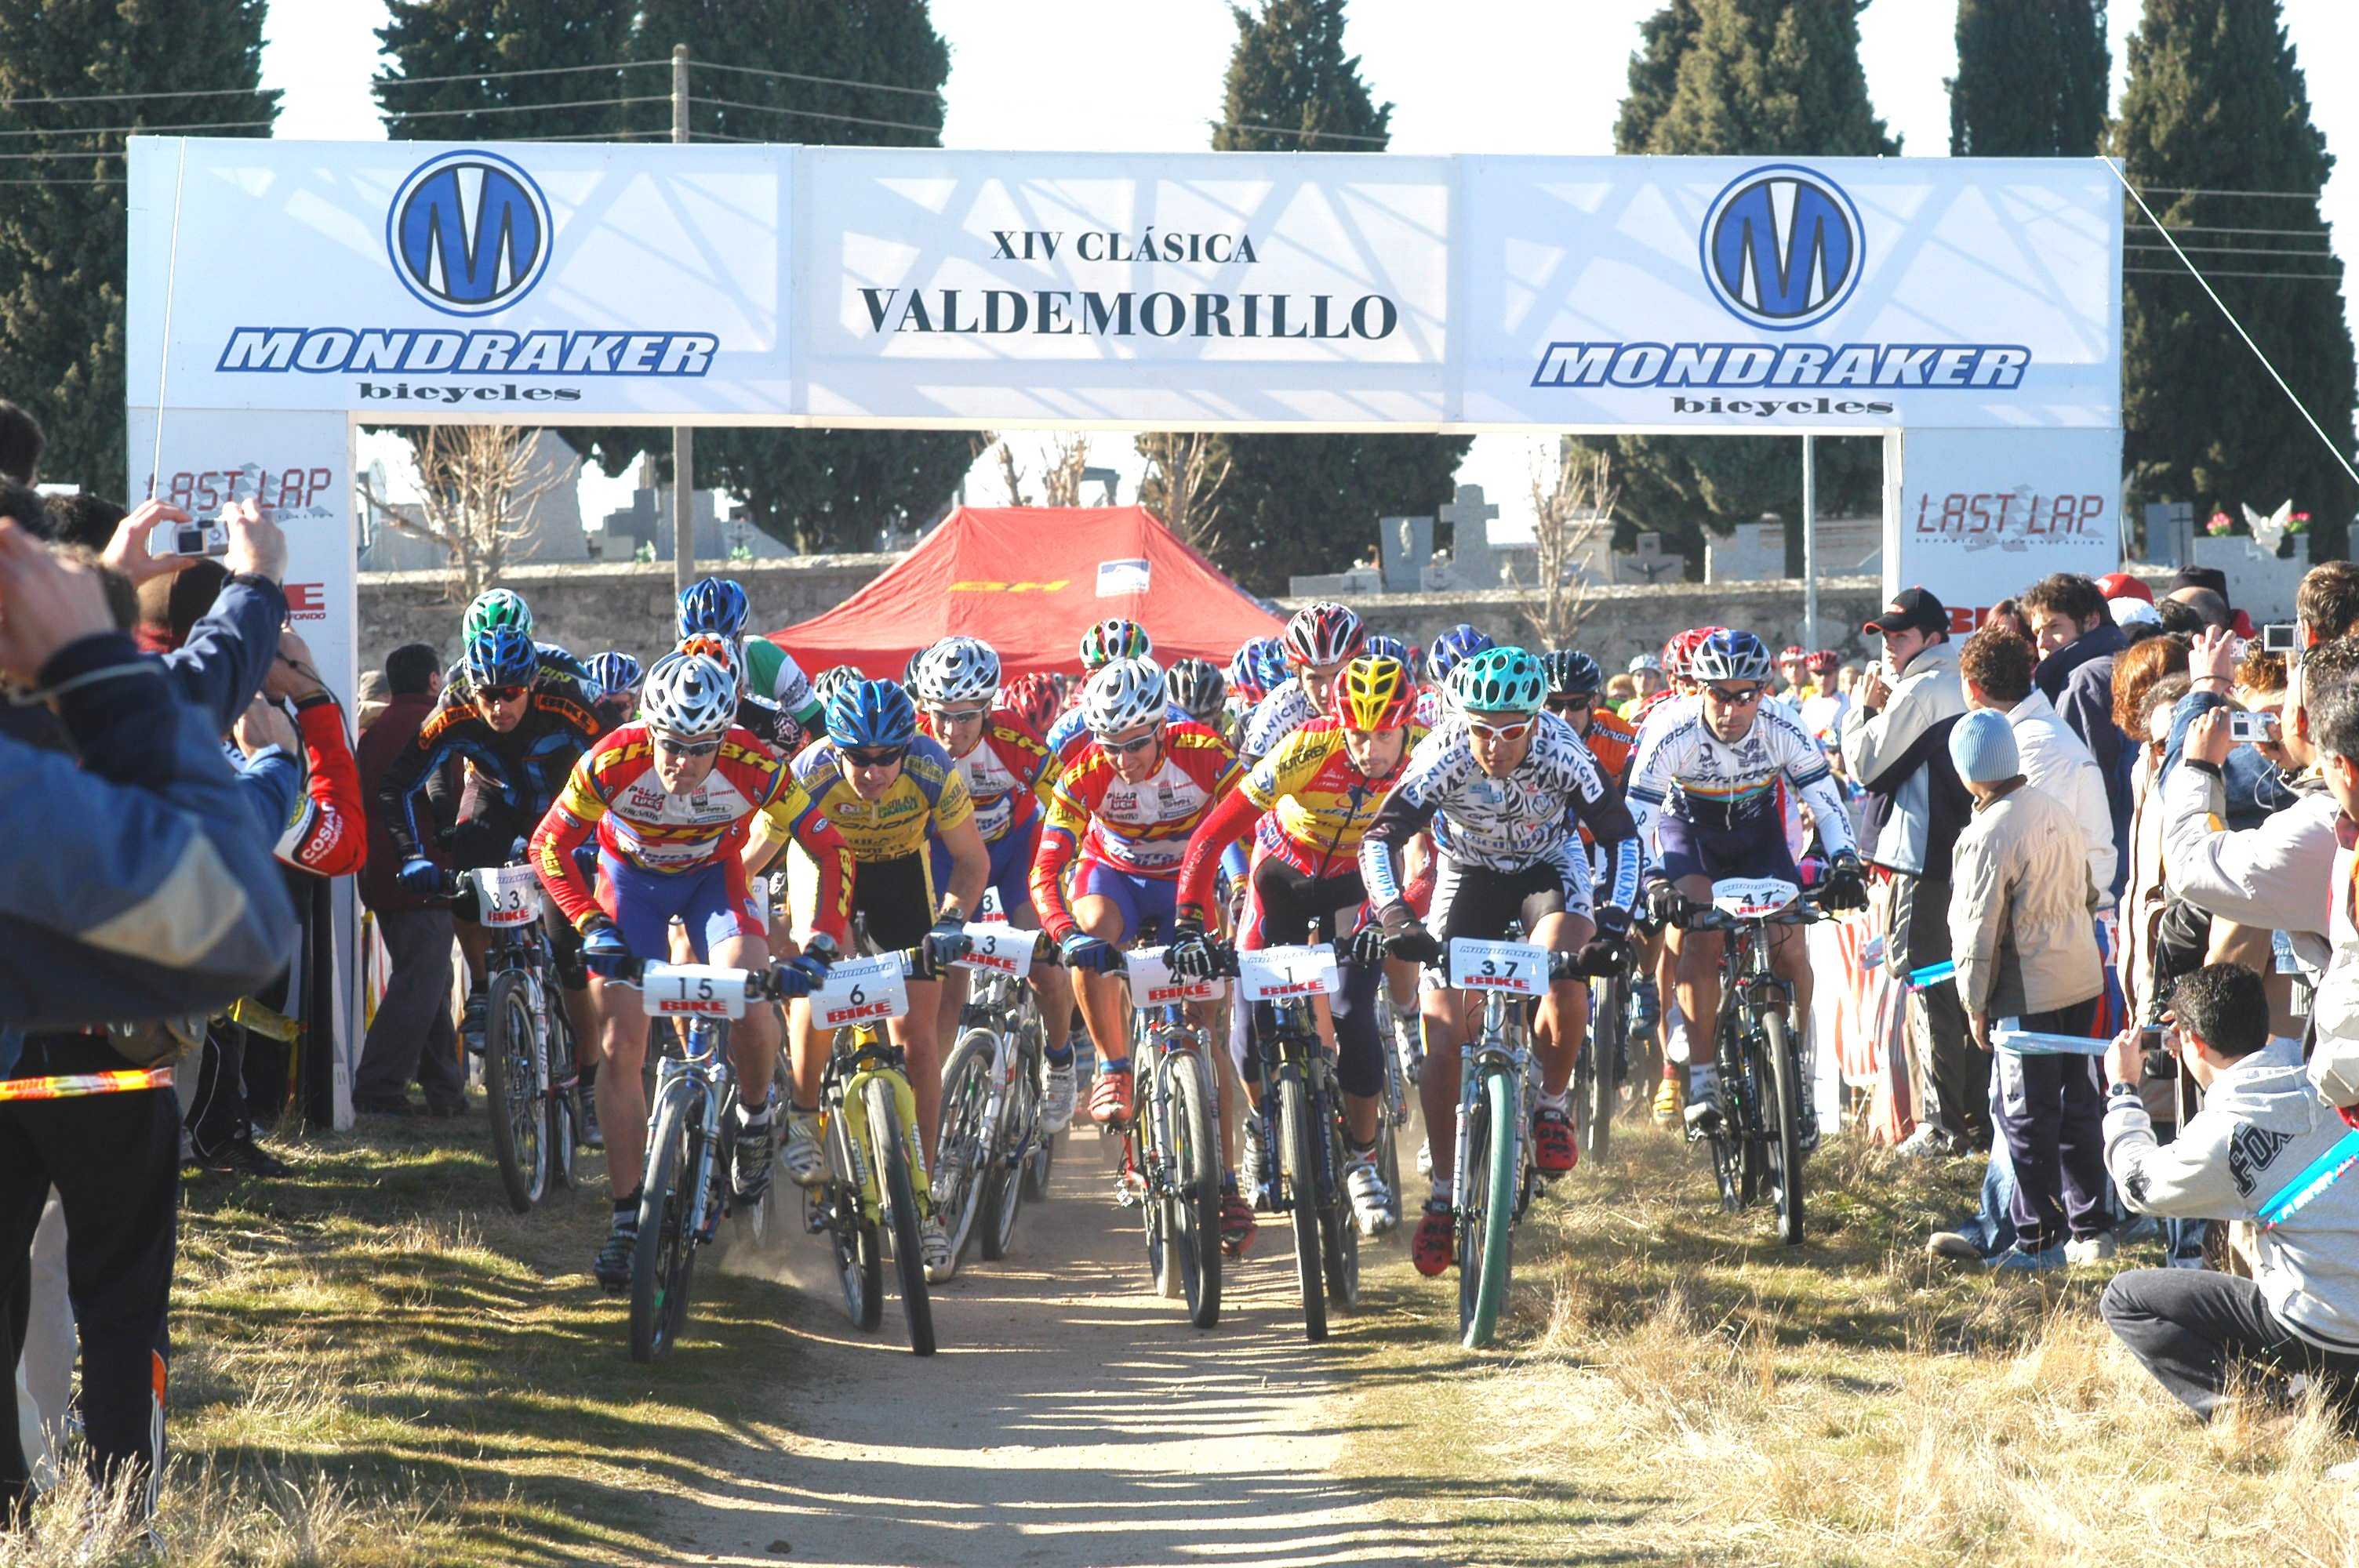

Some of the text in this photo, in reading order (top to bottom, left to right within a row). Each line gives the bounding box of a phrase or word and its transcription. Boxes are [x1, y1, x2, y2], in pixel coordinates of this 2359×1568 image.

[990, 225, 1260, 263] XIV CLÁSICA
[857, 287, 1398, 340] VALDEMORILLO
[215, 326, 720, 377] MONDRAKER
[1530, 341, 2031, 390] MONDRAKER
[355, 382, 582, 404] bicycles
[1670, 396, 1894, 418] bicycles
[257, 468, 332, 509] LAP
[1917, 493, 2104, 535] LAST LAP
[488, 908, 530, 923] BIKE
[982, 935, 997, 954] 3
[1480, 960, 1519, 978] 37
[678, 977, 714, 1000] 15
[849, 983, 865, 1005] 6
[1148, 982, 1212, 1002] BIKE
[1259, 978, 1325, 996] BIKE
[1464, 975, 1531, 992] BIKE
[660, 1000, 728, 1014] BIKE
[827, 999, 893, 1023] BIKE
[2228, 1125, 2295, 1199] FOX
